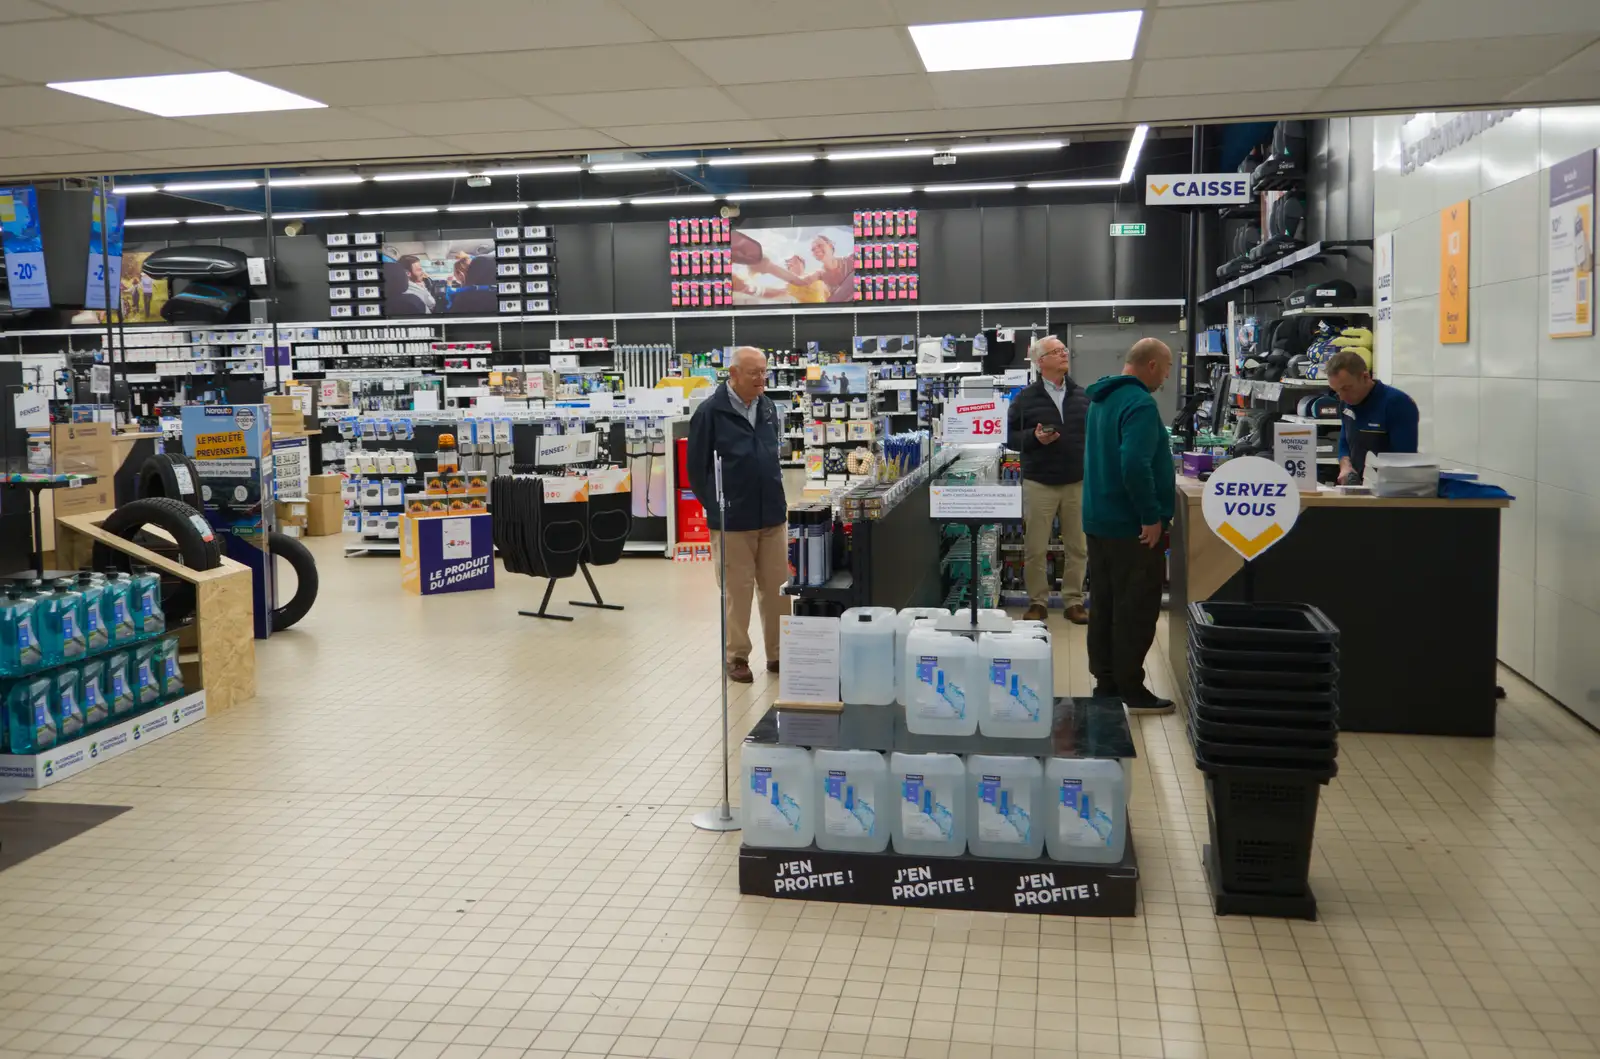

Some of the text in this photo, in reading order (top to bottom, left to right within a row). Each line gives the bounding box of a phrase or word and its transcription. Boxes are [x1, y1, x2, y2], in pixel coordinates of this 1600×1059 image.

[1172, 180, 1246, 197] CAISSE
[205, 407, 233, 415] Norauto
[197, 431, 242, 445] LE PNEU ÉTÉ
[196, 446, 239, 457] PREVENSYS
[1213, 482, 1288, 498] SERVEZ
[1224, 502, 1276, 517] VOUS
[429, 555, 490, 582] LE PRODUIT
[429, 565, 490, 591] DU MOMENT
[776, 859, 813, 877] J'EN
[894, 866, 931, 884] J'EN
[774, 870, 854, 892] PROFITE !
[892, 876, 974, 900] PROFITE !
[1016, 873, 1055, 890] J'EN
[1014, 883, 1100, 907] PROFITE !
